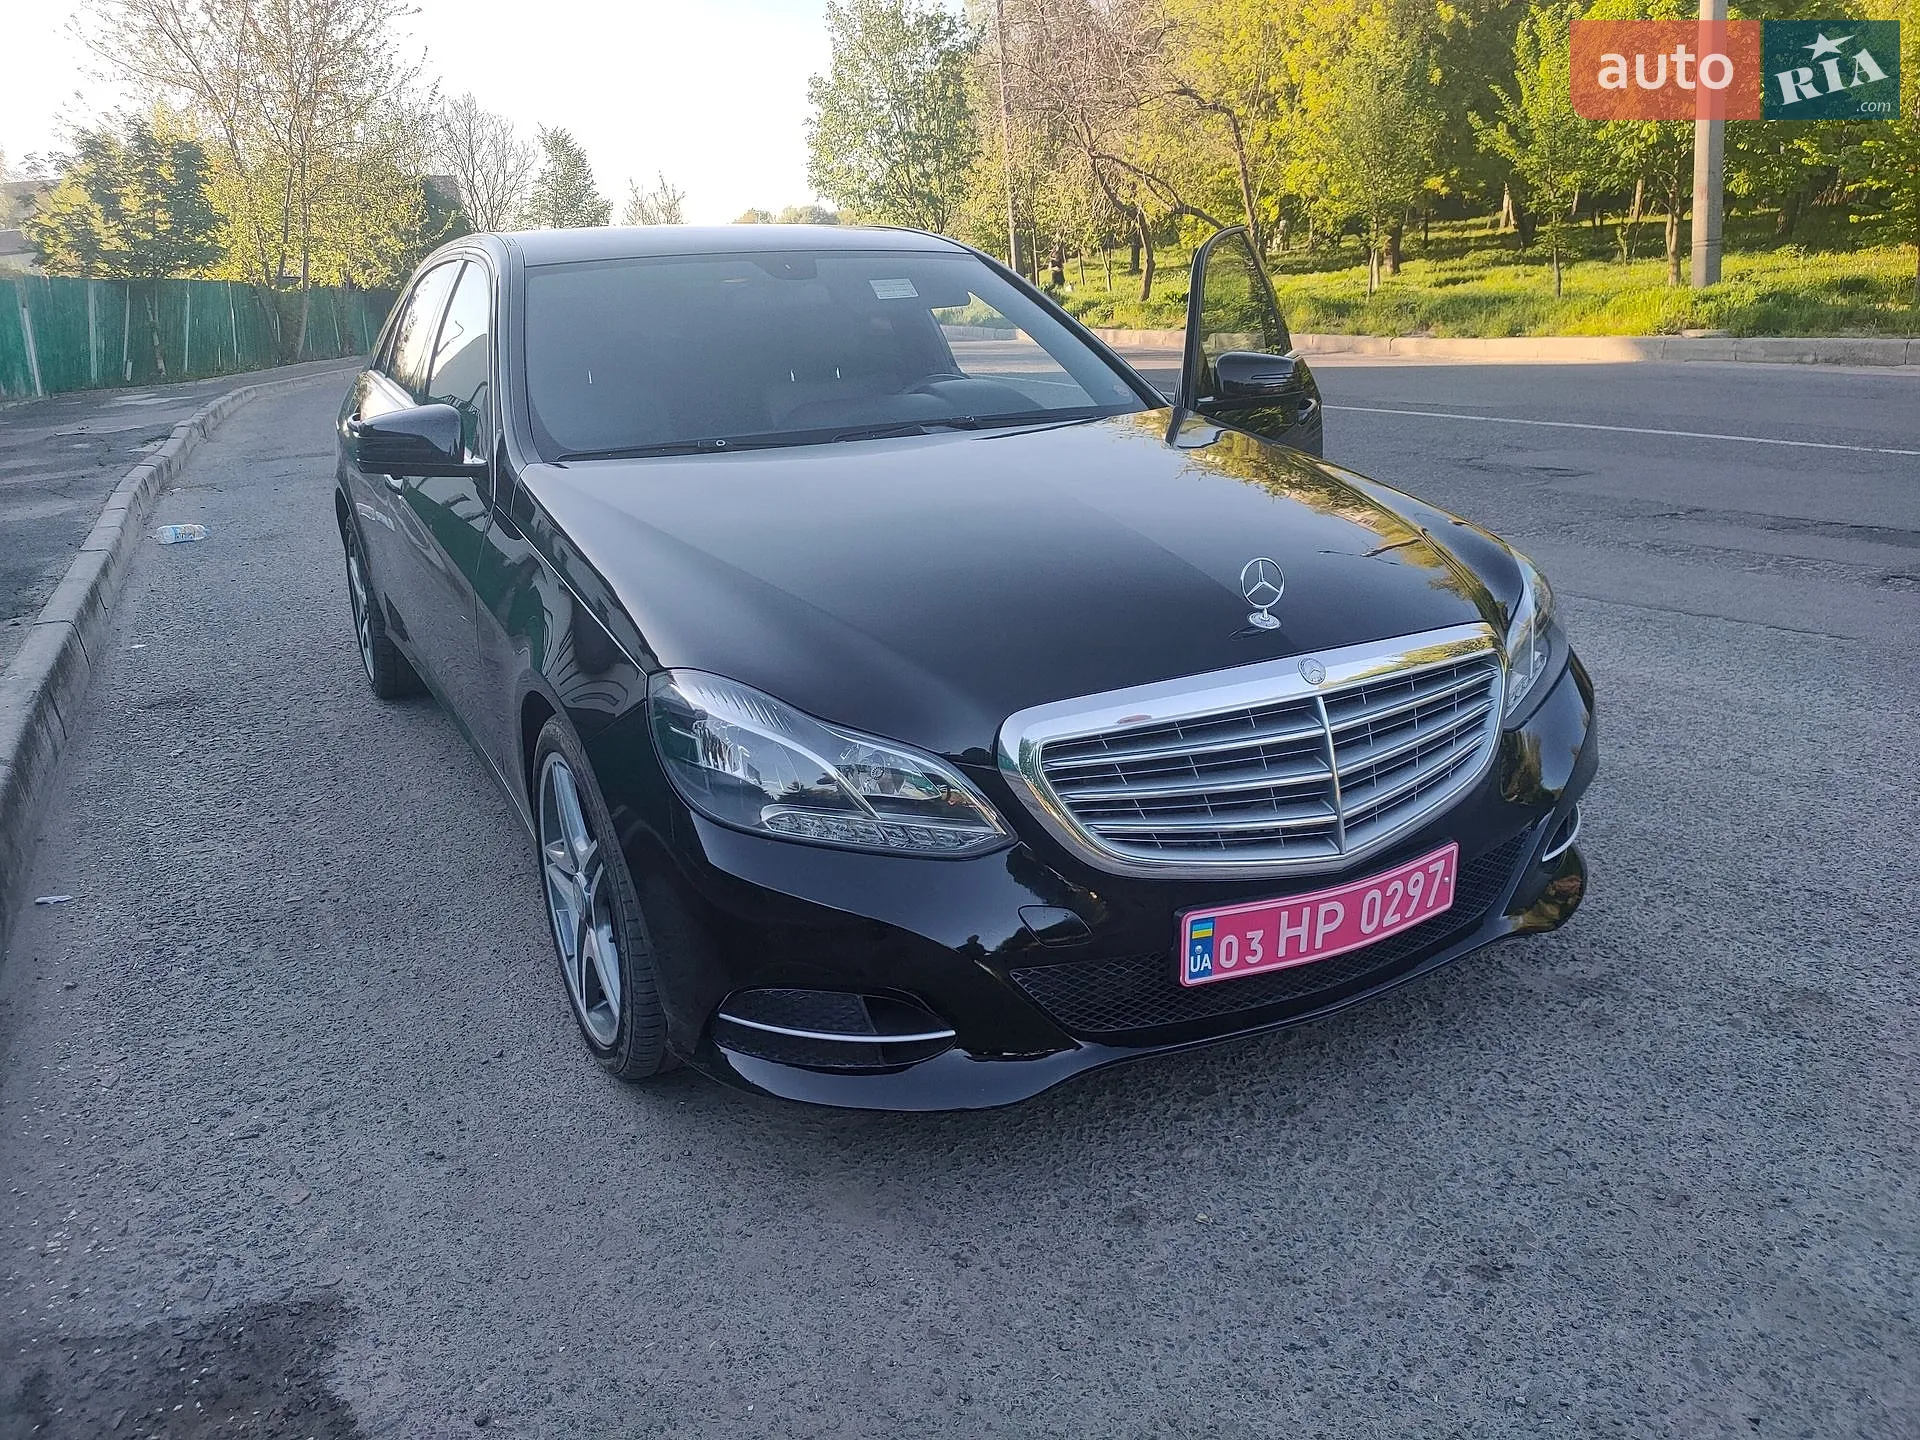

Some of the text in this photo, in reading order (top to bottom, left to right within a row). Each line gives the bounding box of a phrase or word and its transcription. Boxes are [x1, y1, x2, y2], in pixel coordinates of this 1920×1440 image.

[1218, 859, 1446, 969] 03 HP 0297
[1190, 954, 1212, 973] UA
